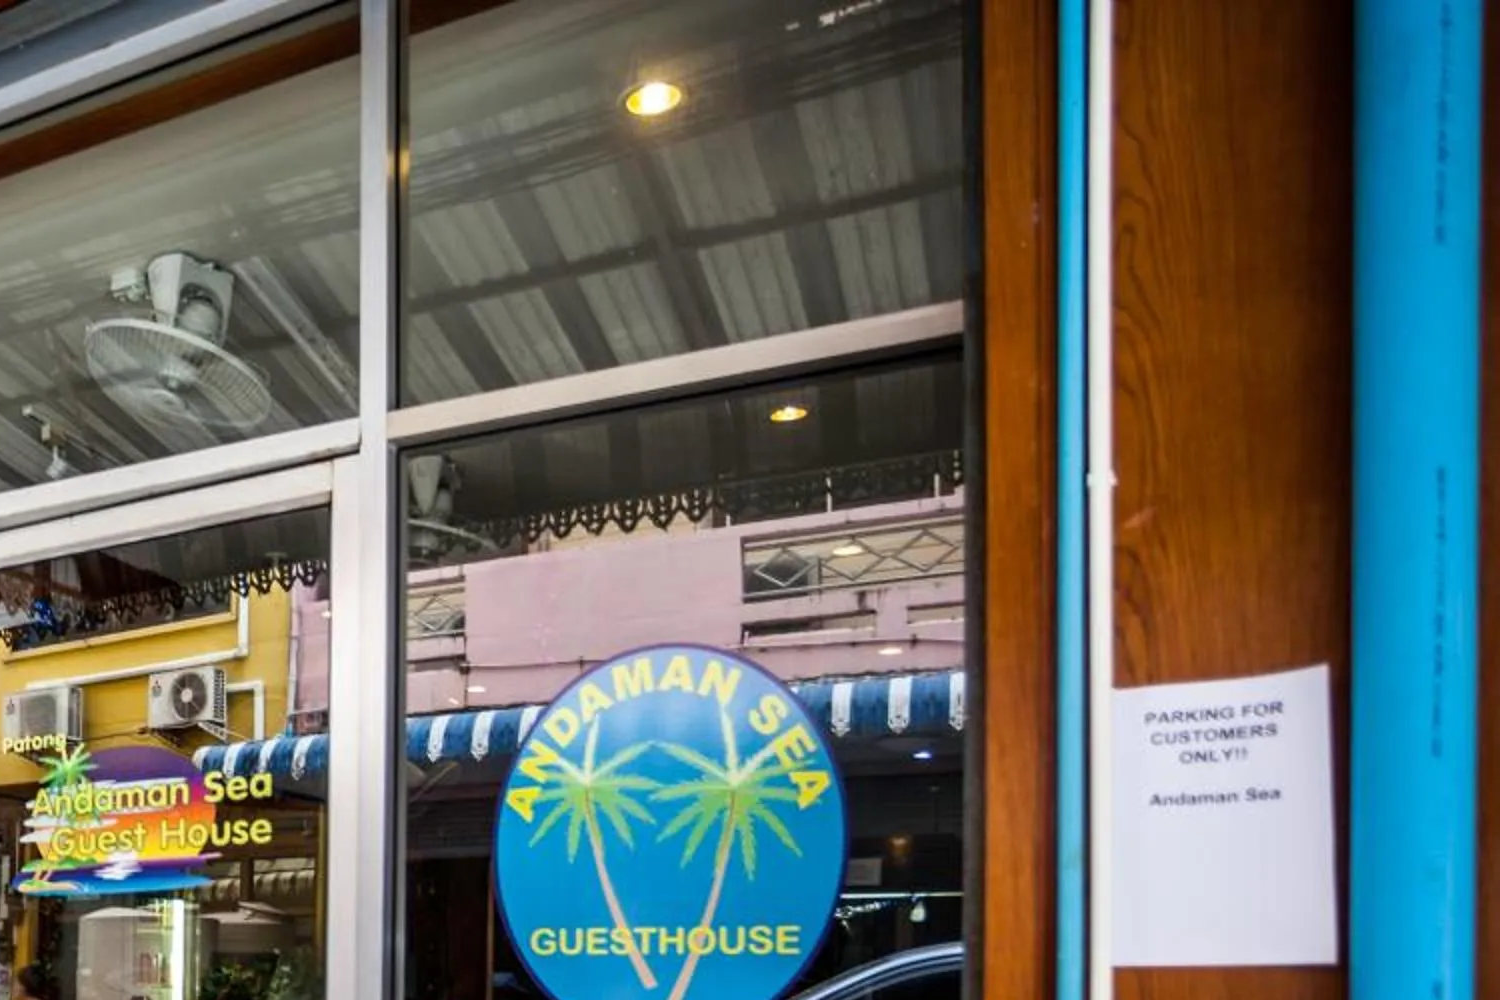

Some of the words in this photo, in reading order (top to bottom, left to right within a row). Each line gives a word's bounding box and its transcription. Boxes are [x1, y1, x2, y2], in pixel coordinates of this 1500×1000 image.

[1144, 705, 1236, 724] PARKING
[1241, 700, 1285, 718] FOR
[3, 733, 68, 755] Patong
[506, 654, 742, 823] ANDAMAN
[748, 694, 831, 810] SEA
[1150, 723, 1279, 746] CUSTOMERS
[1178, 746, 1249, 765] ONLY!!
[32, 780, 191, 817] Andaman
[203, 770, 274, 804] Sea
[1149, 790, 1239, 807] Andaman
[1246, 785, 1282, 801] Sea
[52, 820, 147, 856] Guest
[160, 817, 274, 850] House
[530, 924, 802, 957] GUESTHOUSE
